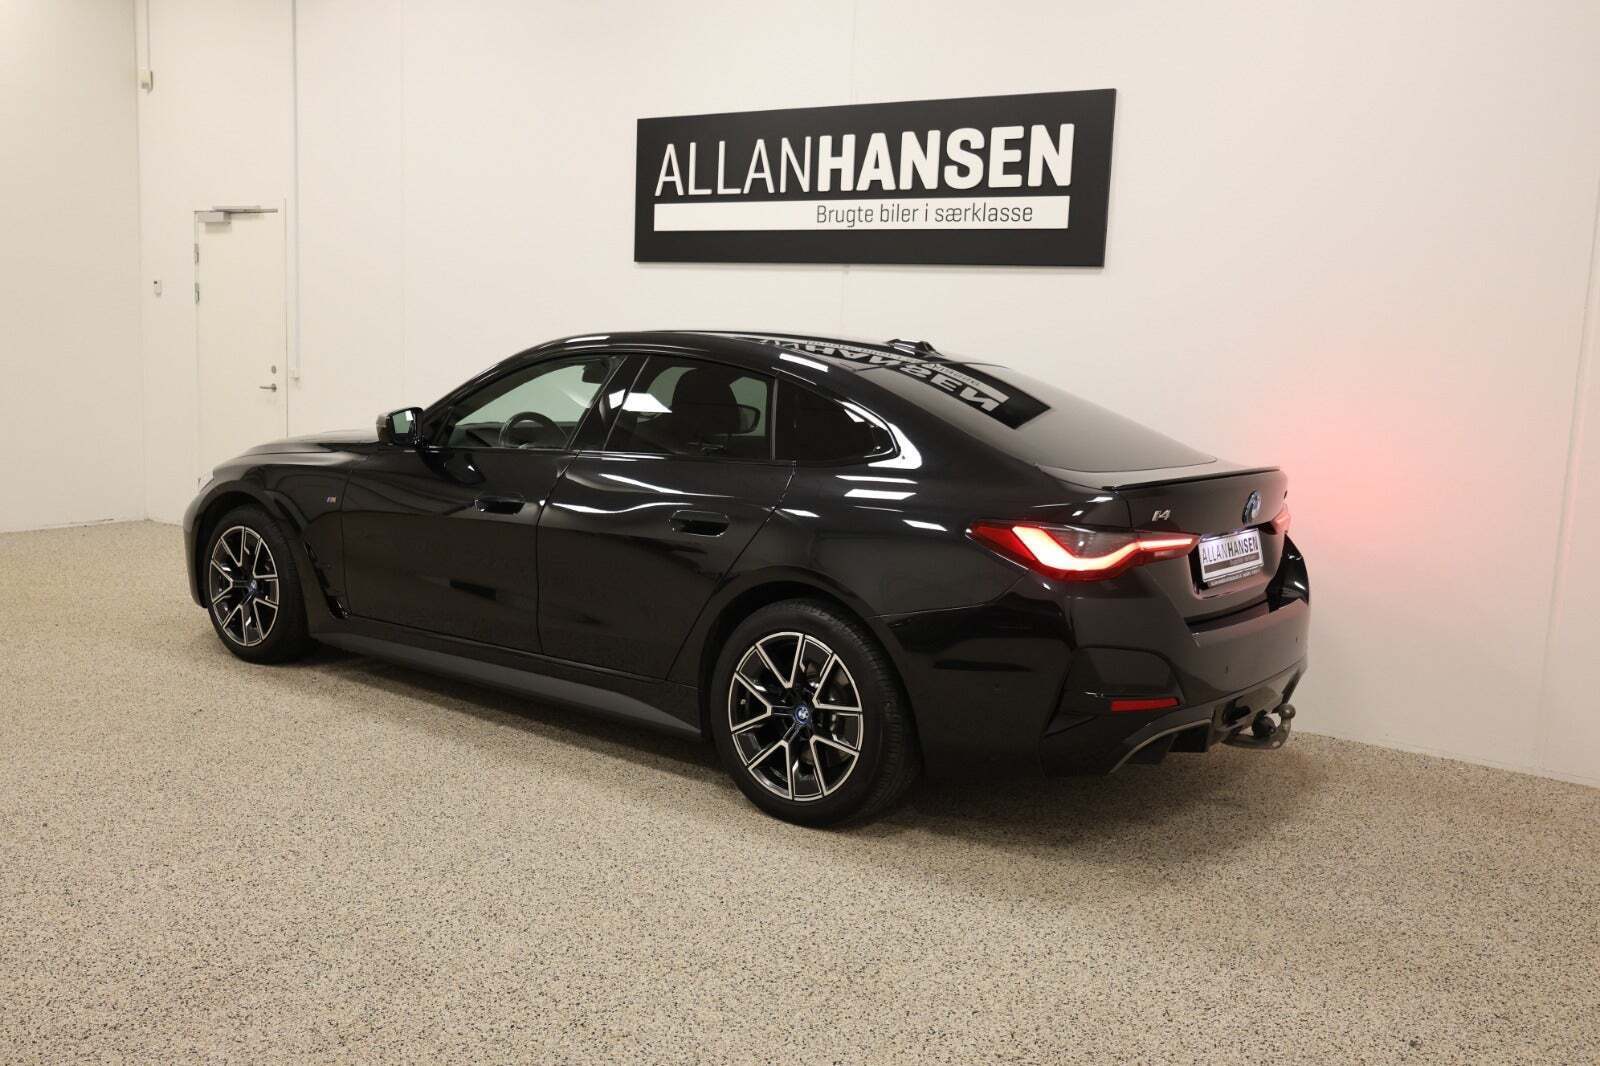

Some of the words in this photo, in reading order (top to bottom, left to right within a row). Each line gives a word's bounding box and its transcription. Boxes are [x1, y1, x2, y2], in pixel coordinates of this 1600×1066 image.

[655, 123, 1075, 197] ALLANHANSEN
[816, 204, 874, 228] Brugte
[880, 203, 919, 223] biler
[924, 203, 929, 222] i
[934, 202, 1033, 223] særklasse
[1202, 536, 1259, 564] ALLANHANSEN
